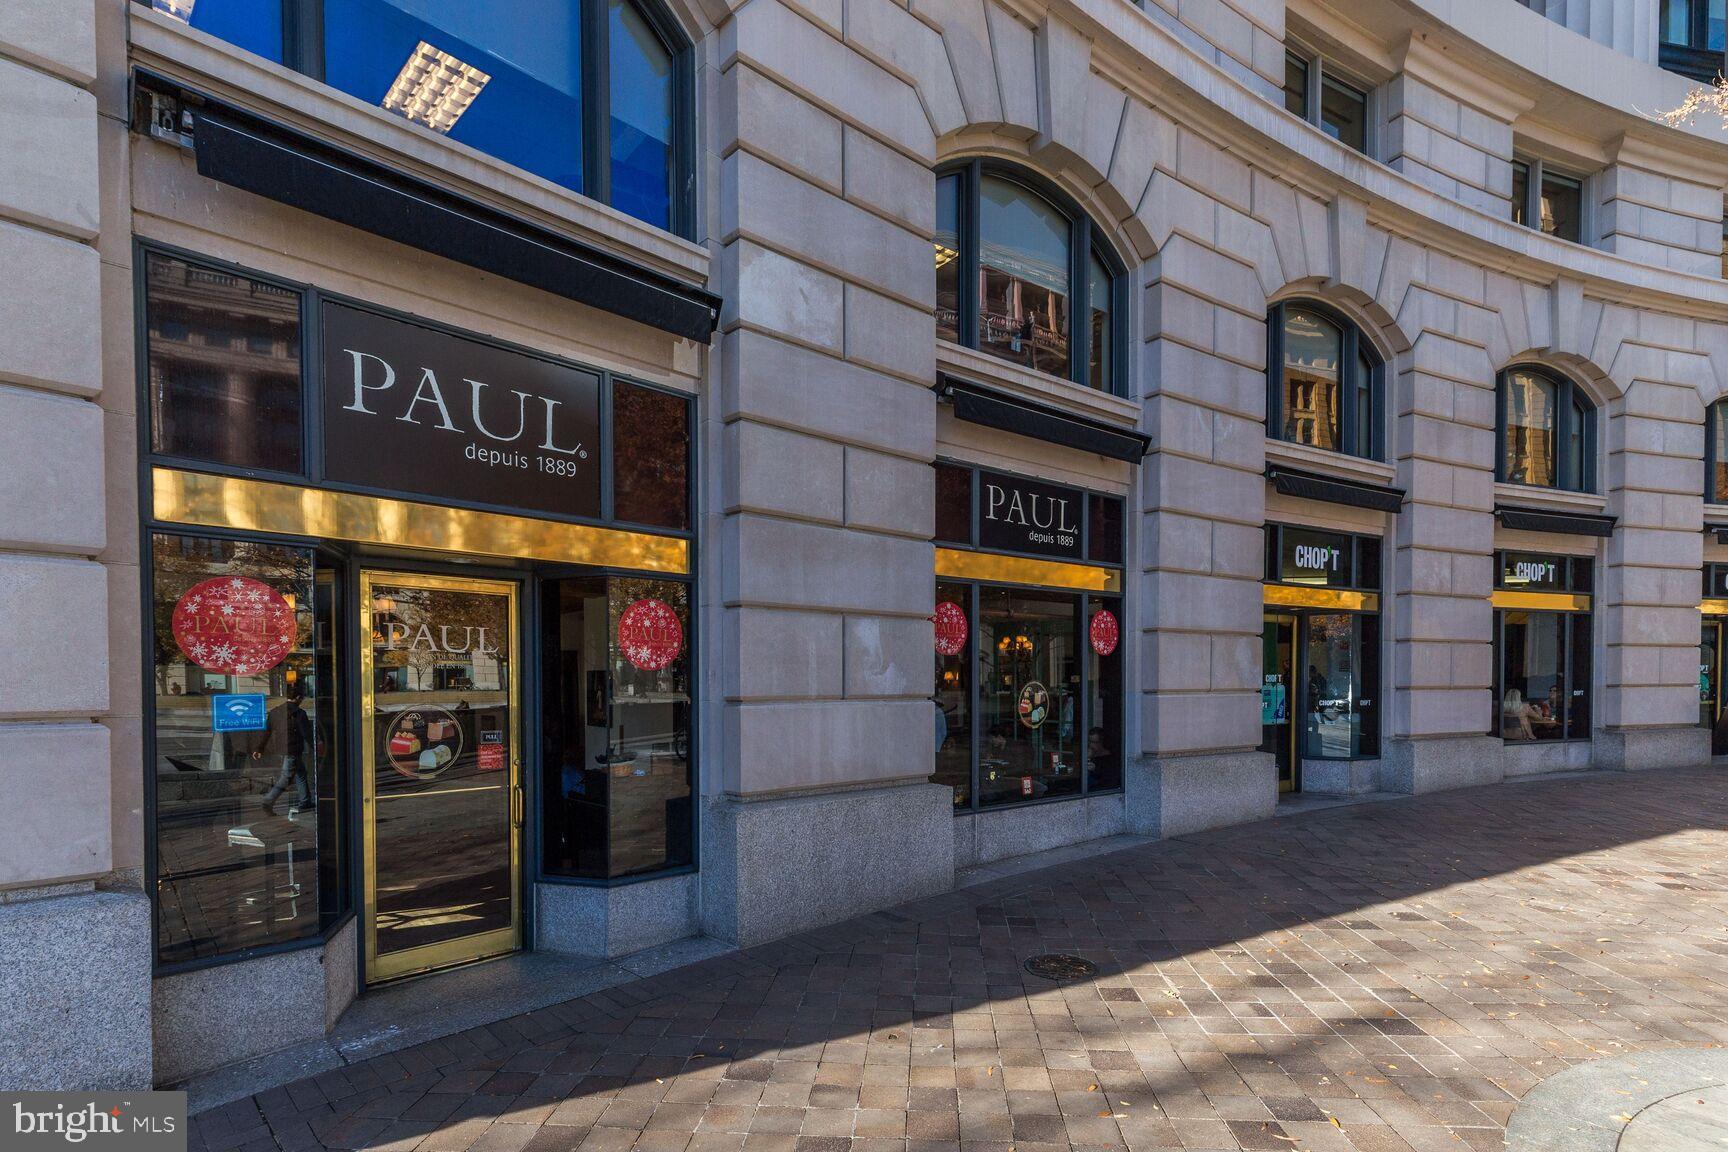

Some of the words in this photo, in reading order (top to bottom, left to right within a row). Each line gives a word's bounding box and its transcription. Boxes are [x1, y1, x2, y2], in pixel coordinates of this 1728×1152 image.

[464, 442, 529, 469] depuis
[536, 455, 578, 477] 1889
[1028, 530, 1055, 545] depuis
[1056, 534, 1074, 547] 1889
[193, 615, 278, 636] PAUL
[628, 626, 672, 641] PAUL
[383, 621, 500, 654] PAUL
[219, 718, 240, 727] Free
